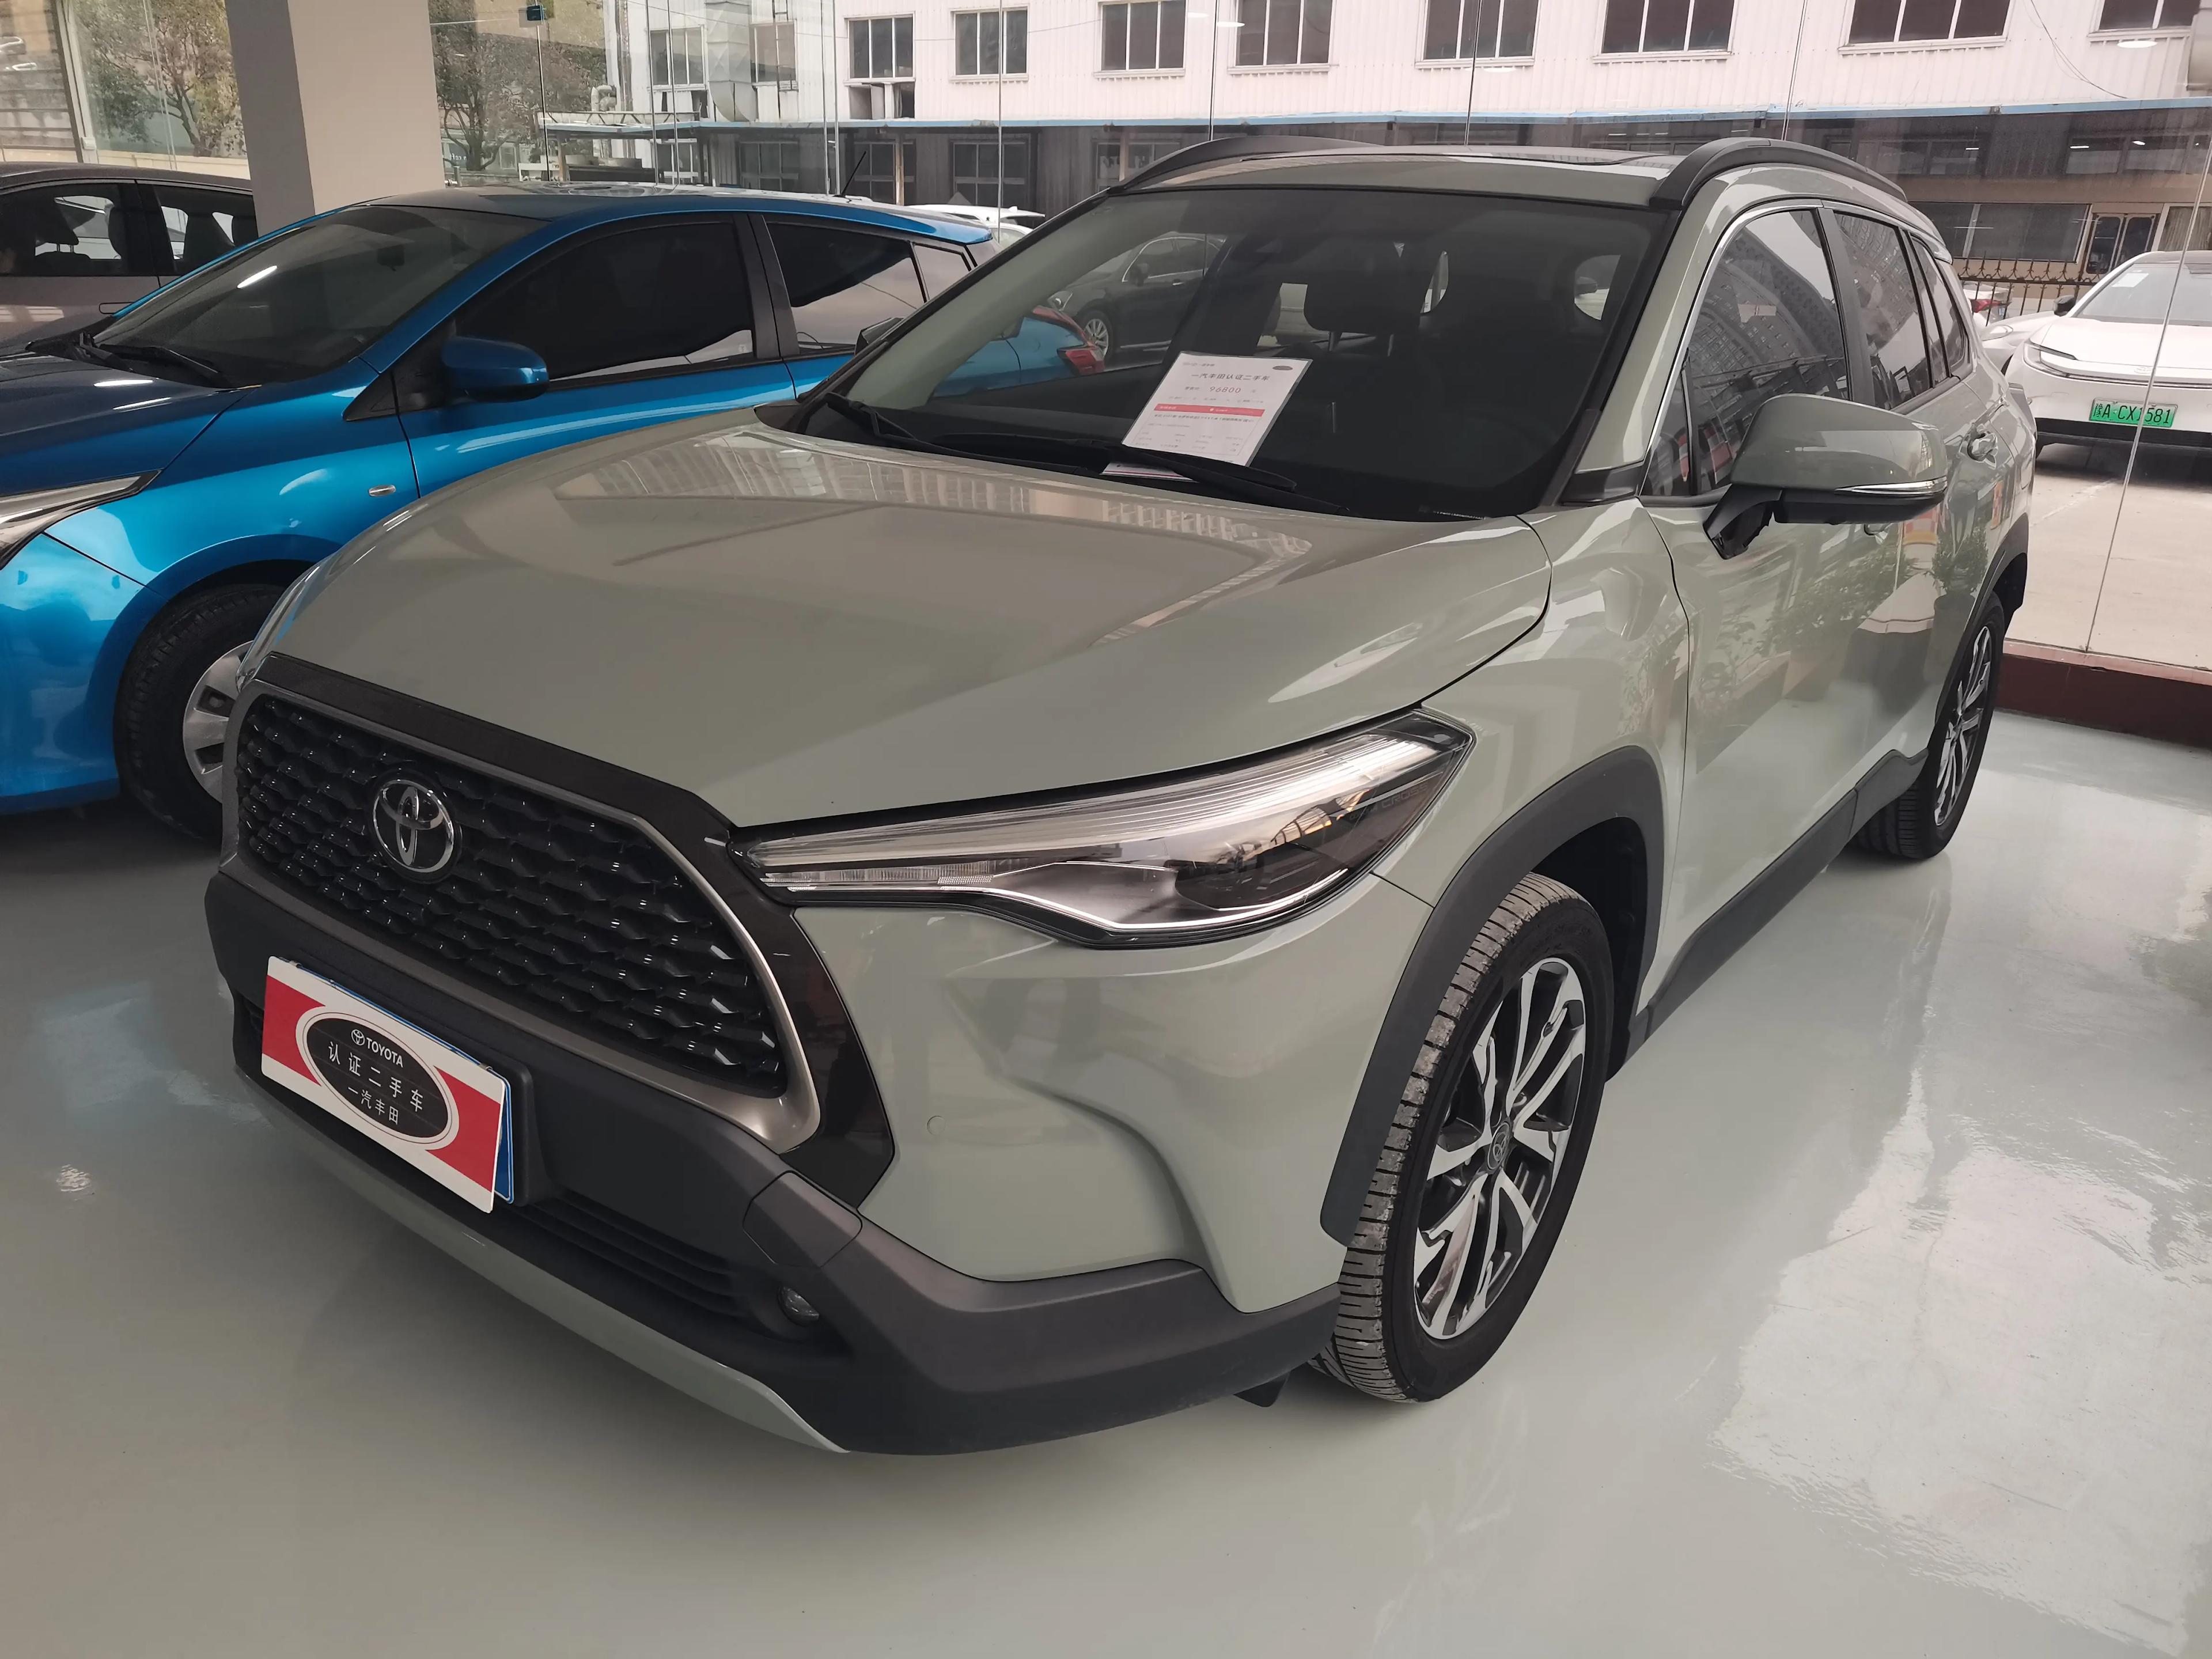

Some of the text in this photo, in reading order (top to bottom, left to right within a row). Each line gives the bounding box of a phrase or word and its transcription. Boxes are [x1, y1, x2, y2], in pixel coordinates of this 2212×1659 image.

[1191, 373, 1270, 381] 一汽丰田认证二手车
[1381, 782, 1428, 809] CROSS
[366, 1037, 403, 1068] TOYOTA
[328, 1041, 423, 1112] 认证二手车
[348, 1086, 399, 1125] 一汽丰田
